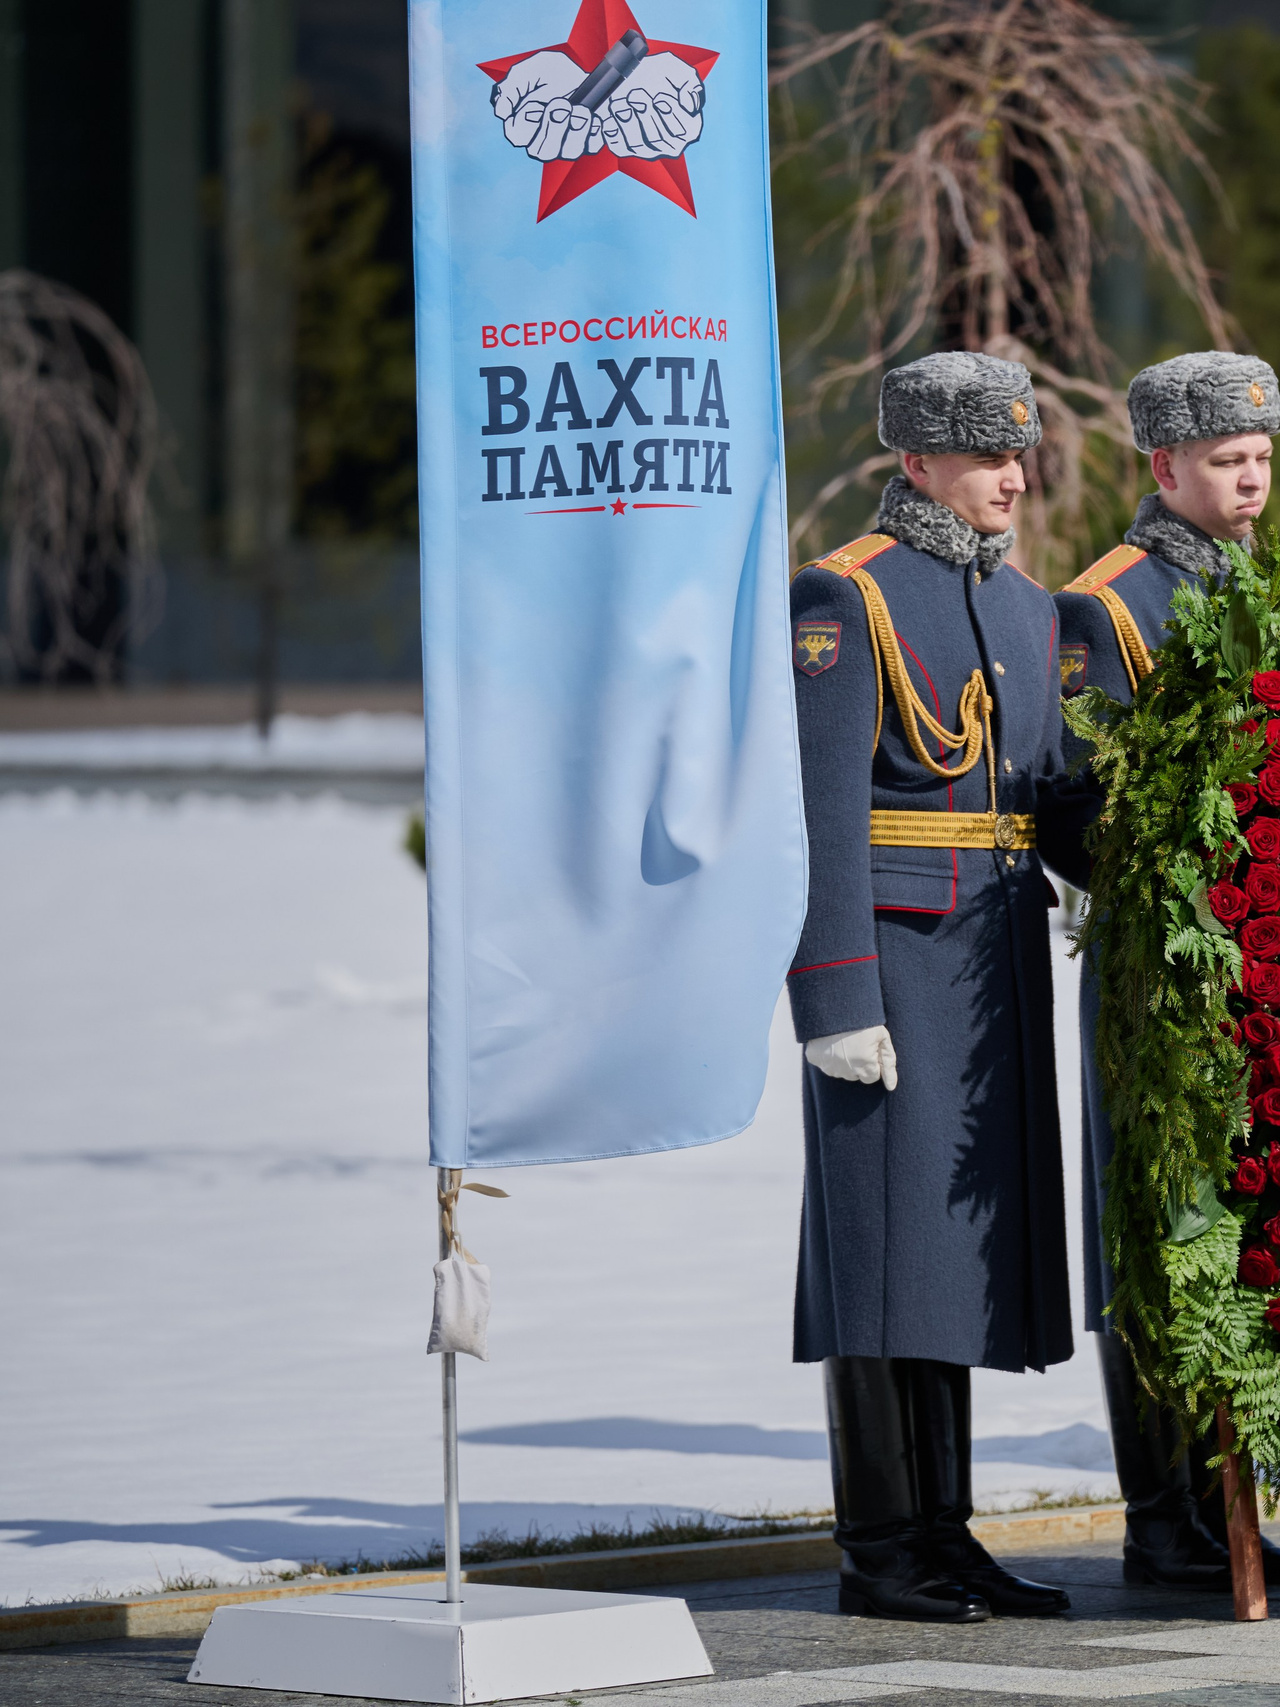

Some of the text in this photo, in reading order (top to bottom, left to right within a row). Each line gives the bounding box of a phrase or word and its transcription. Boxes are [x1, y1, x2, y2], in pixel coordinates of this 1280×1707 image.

[481, 309, 727, 348] ВСЕРОССИЙСКАЯ
[479, 356, 730, 436] ВАХТА
[481, 438, 732, 502] ПАМЯТИ
